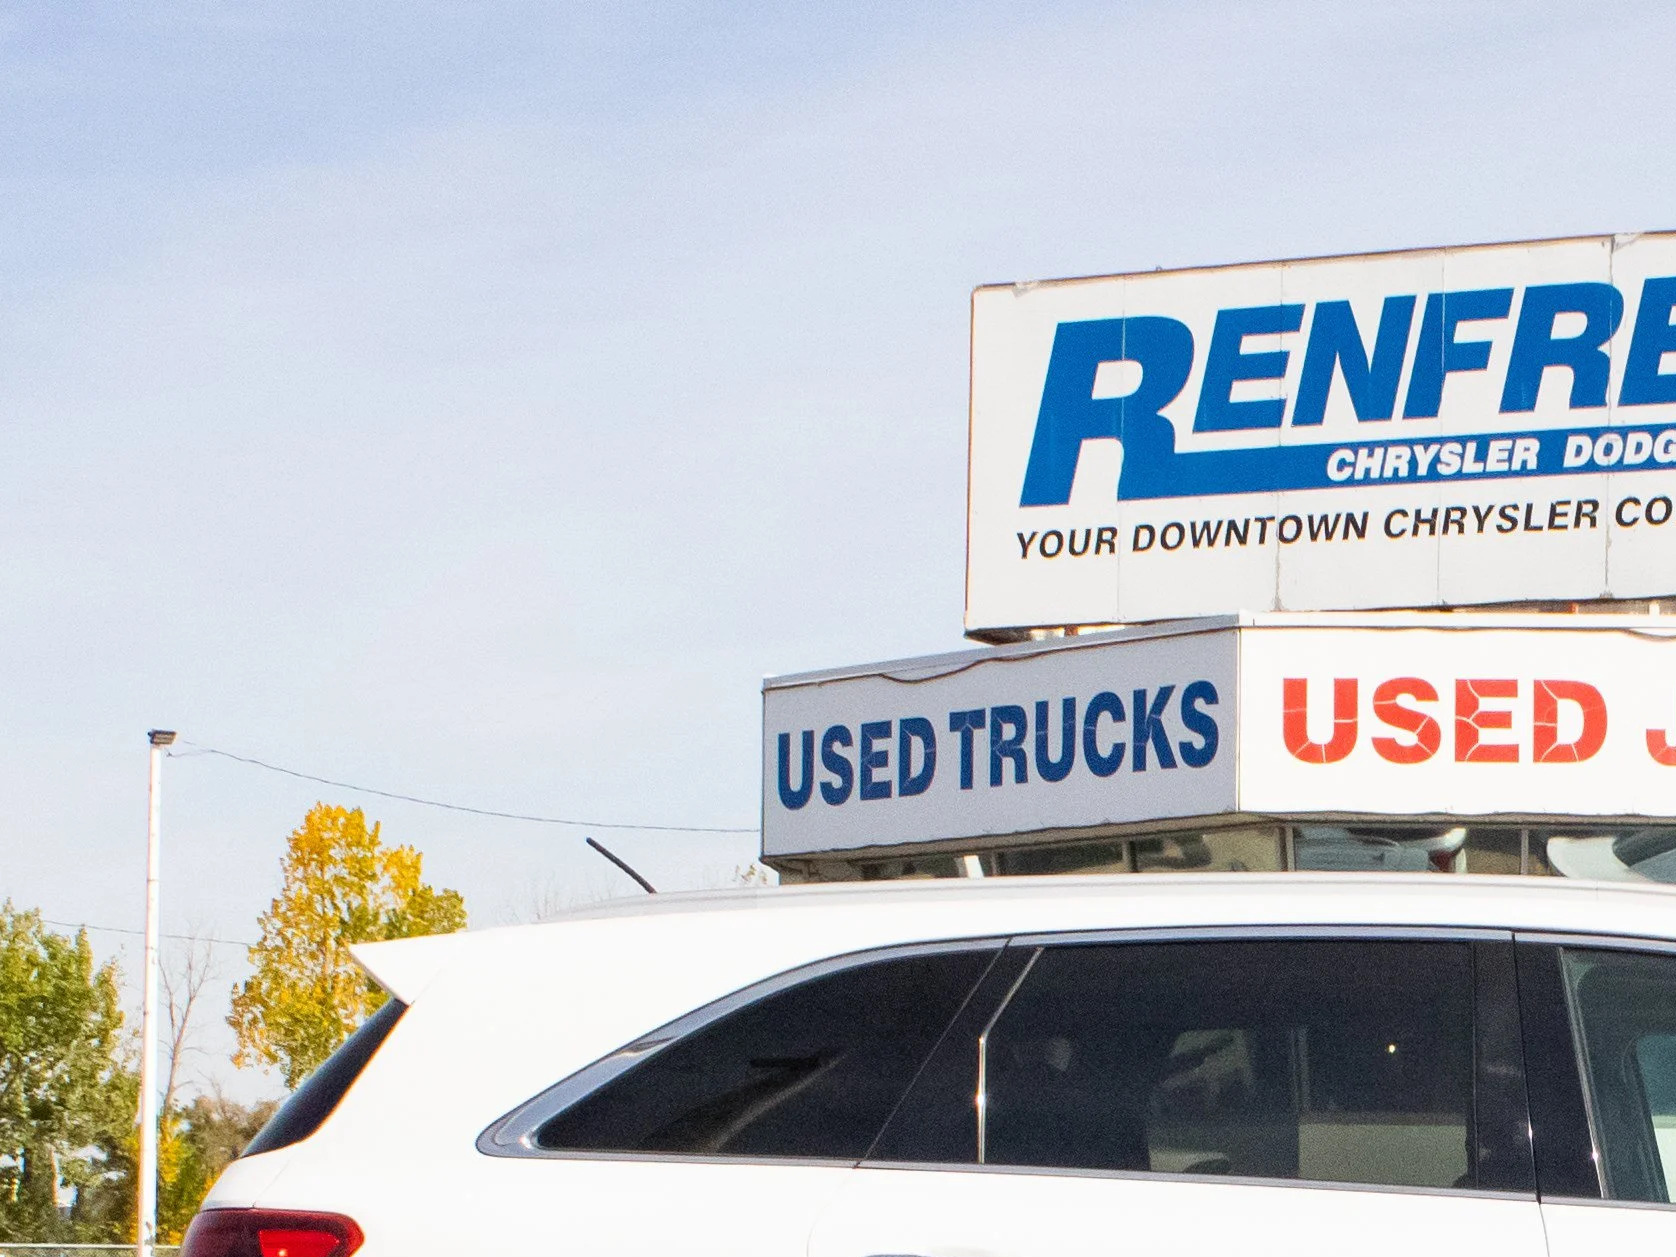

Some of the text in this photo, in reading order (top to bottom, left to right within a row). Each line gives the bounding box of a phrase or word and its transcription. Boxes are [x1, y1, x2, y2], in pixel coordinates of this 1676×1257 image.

[1327, 437, 1540, 482] CHRYSLER
[1016, 526, 1119, 561] YOUR
[1132, 511, 1370, 553] DOWNTOWN
[1384, 497, 1601, 538] CHRYSLER
[776, 680, 1220, 811] USED TRUCKS
[1282, 676, 1609, 765] USED
